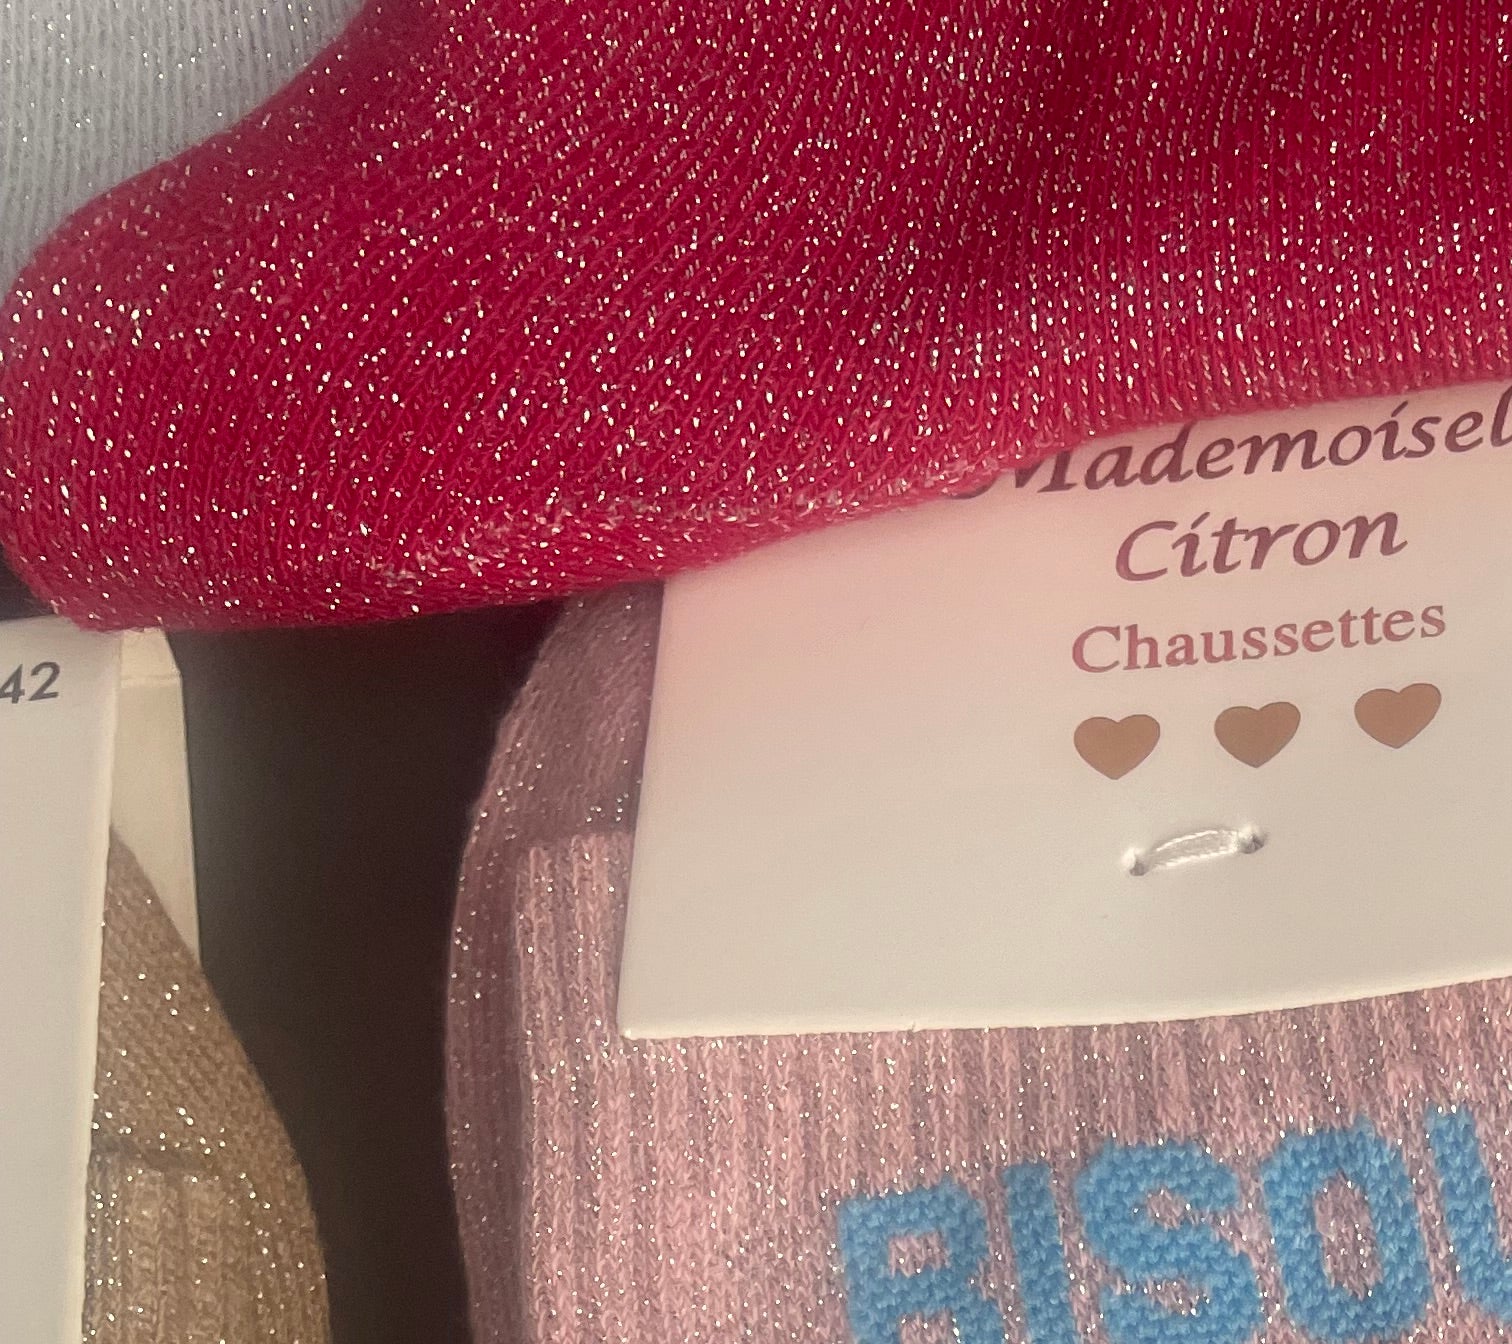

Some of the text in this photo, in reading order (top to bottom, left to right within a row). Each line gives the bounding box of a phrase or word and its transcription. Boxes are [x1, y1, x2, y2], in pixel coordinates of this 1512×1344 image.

[1115, 510, 1408, 582] Citron
[1072, 604, 1447, 673] Chaussettes
[0, 661, 61, 704] 42
